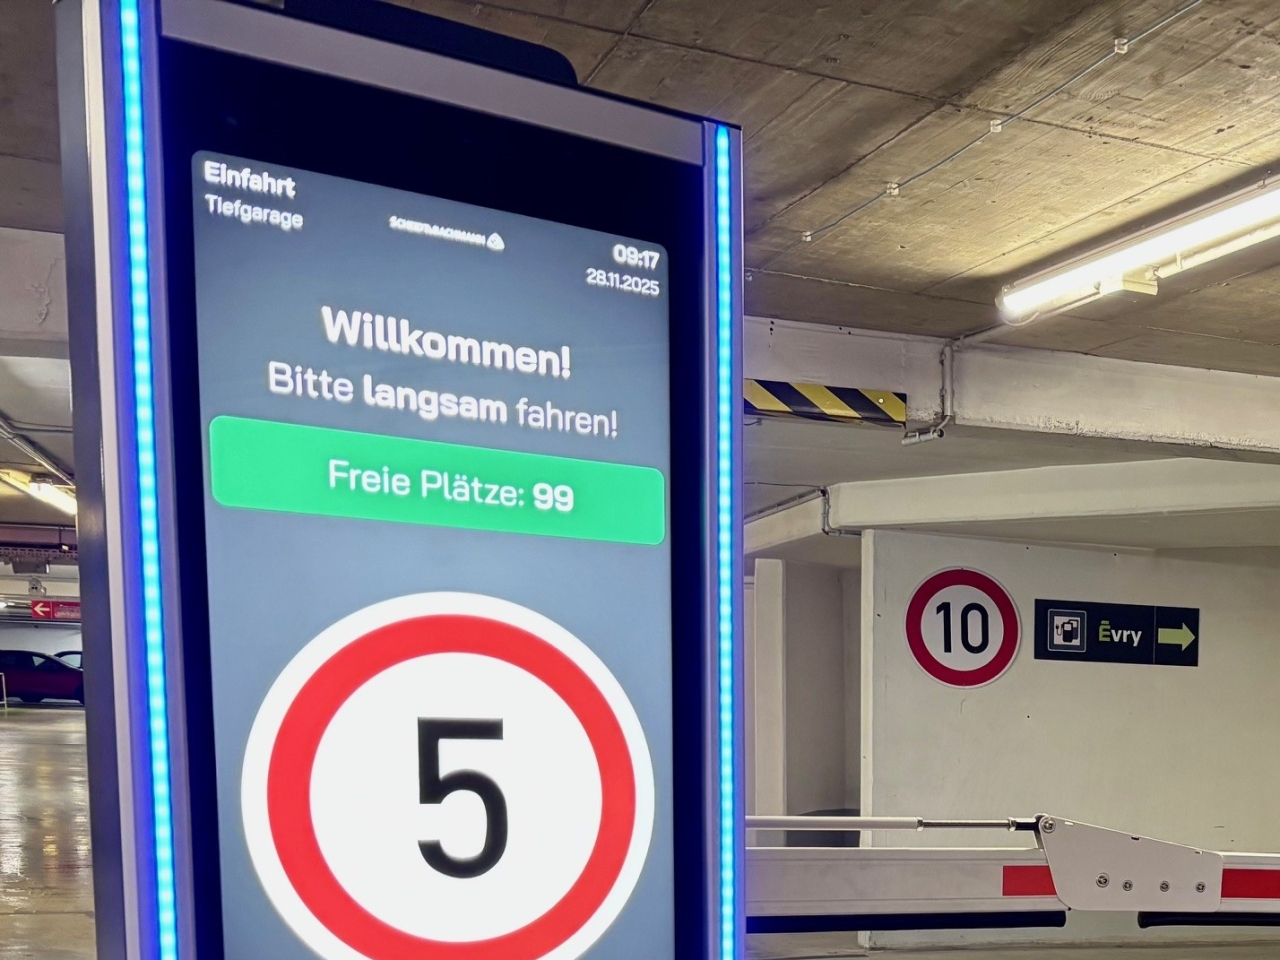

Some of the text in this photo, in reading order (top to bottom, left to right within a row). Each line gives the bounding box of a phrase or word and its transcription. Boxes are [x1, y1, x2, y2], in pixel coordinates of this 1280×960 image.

[204, 160, 296, 198] Einfahrt
[205, 194, 303, 230] Tiefgarage
[586, 267, 660, 295] 28.11.2025
[612, 243, 660, 269] 09:17
[321, 305, 571, 378] Willkommen!
[268, 361, 618, 438] Bitte langsam fahren!
[328, 459, 575, 512] Freie Plätze: 99
[936, 601, 989, 654] 10
[417, 716, 508, 879] 5
